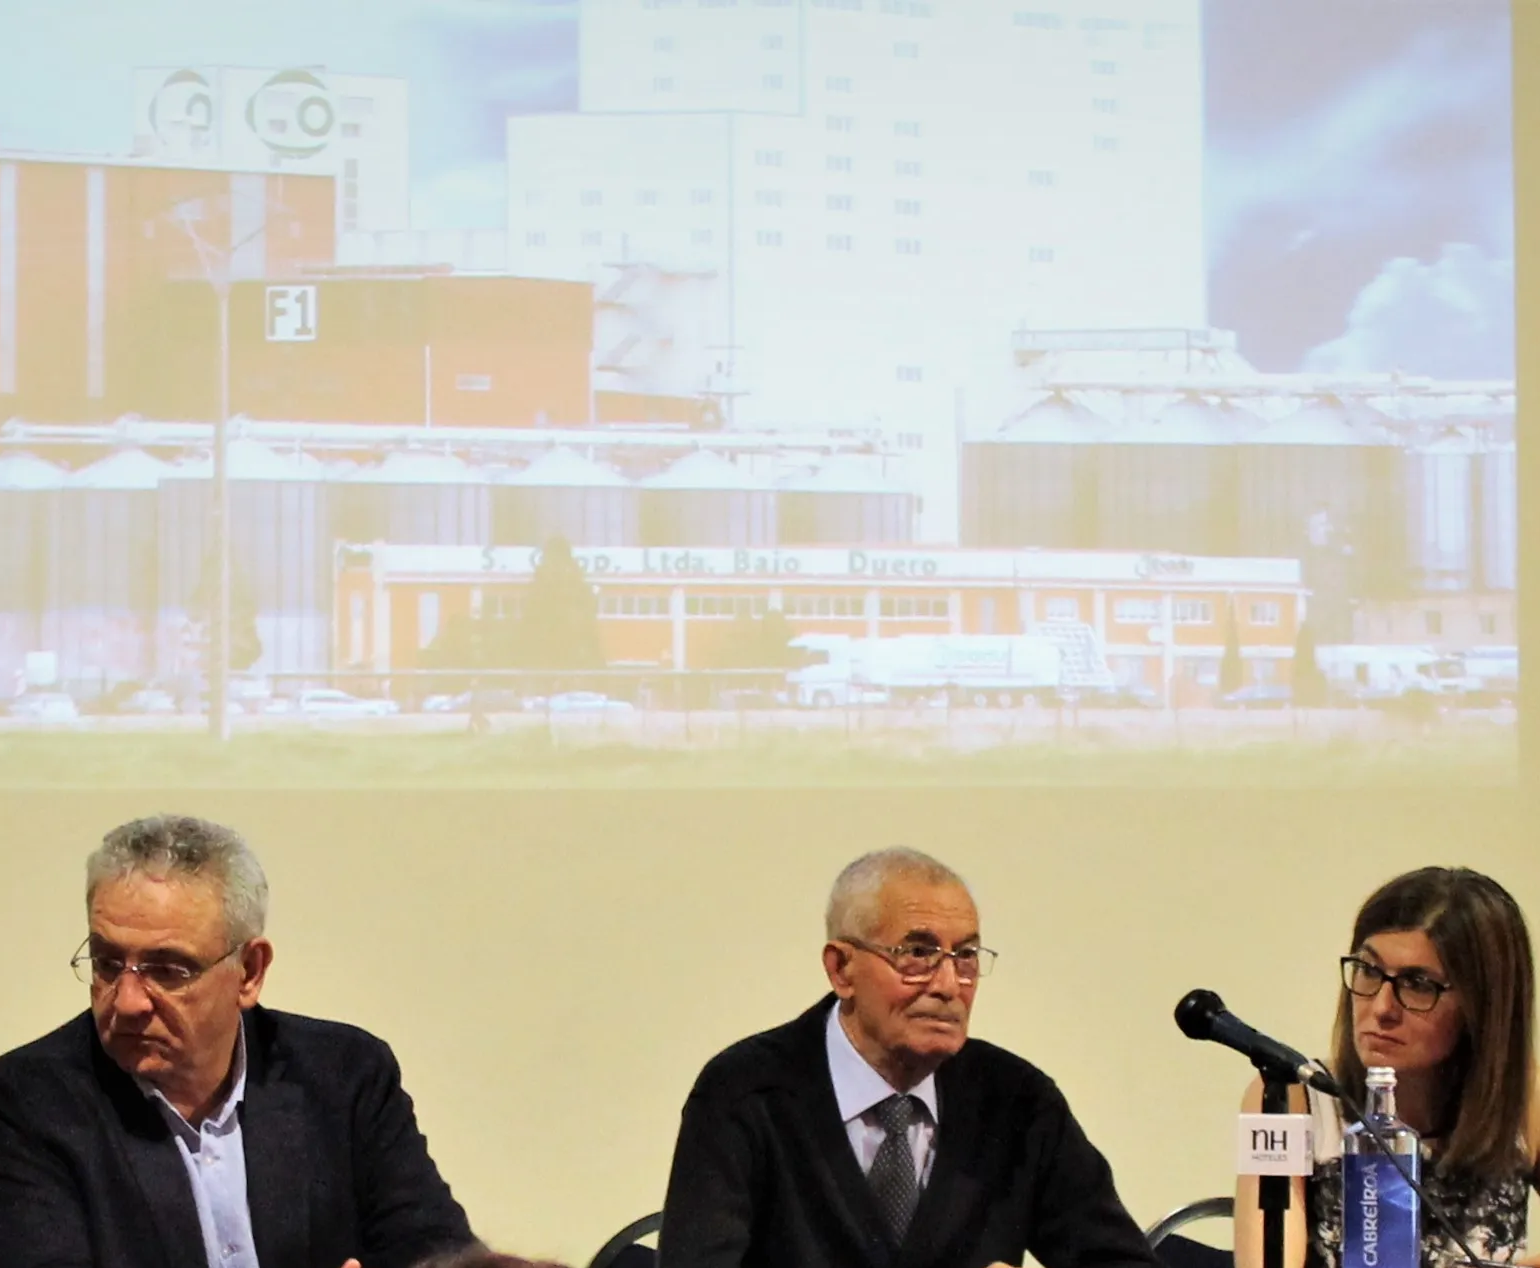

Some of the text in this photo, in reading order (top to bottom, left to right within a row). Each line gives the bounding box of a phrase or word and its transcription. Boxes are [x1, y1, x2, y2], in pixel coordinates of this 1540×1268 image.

[268, 289, 312, 336] F1
[734, 547, 801, 574] Bajo
[849, 549, 938, 577] Duero
